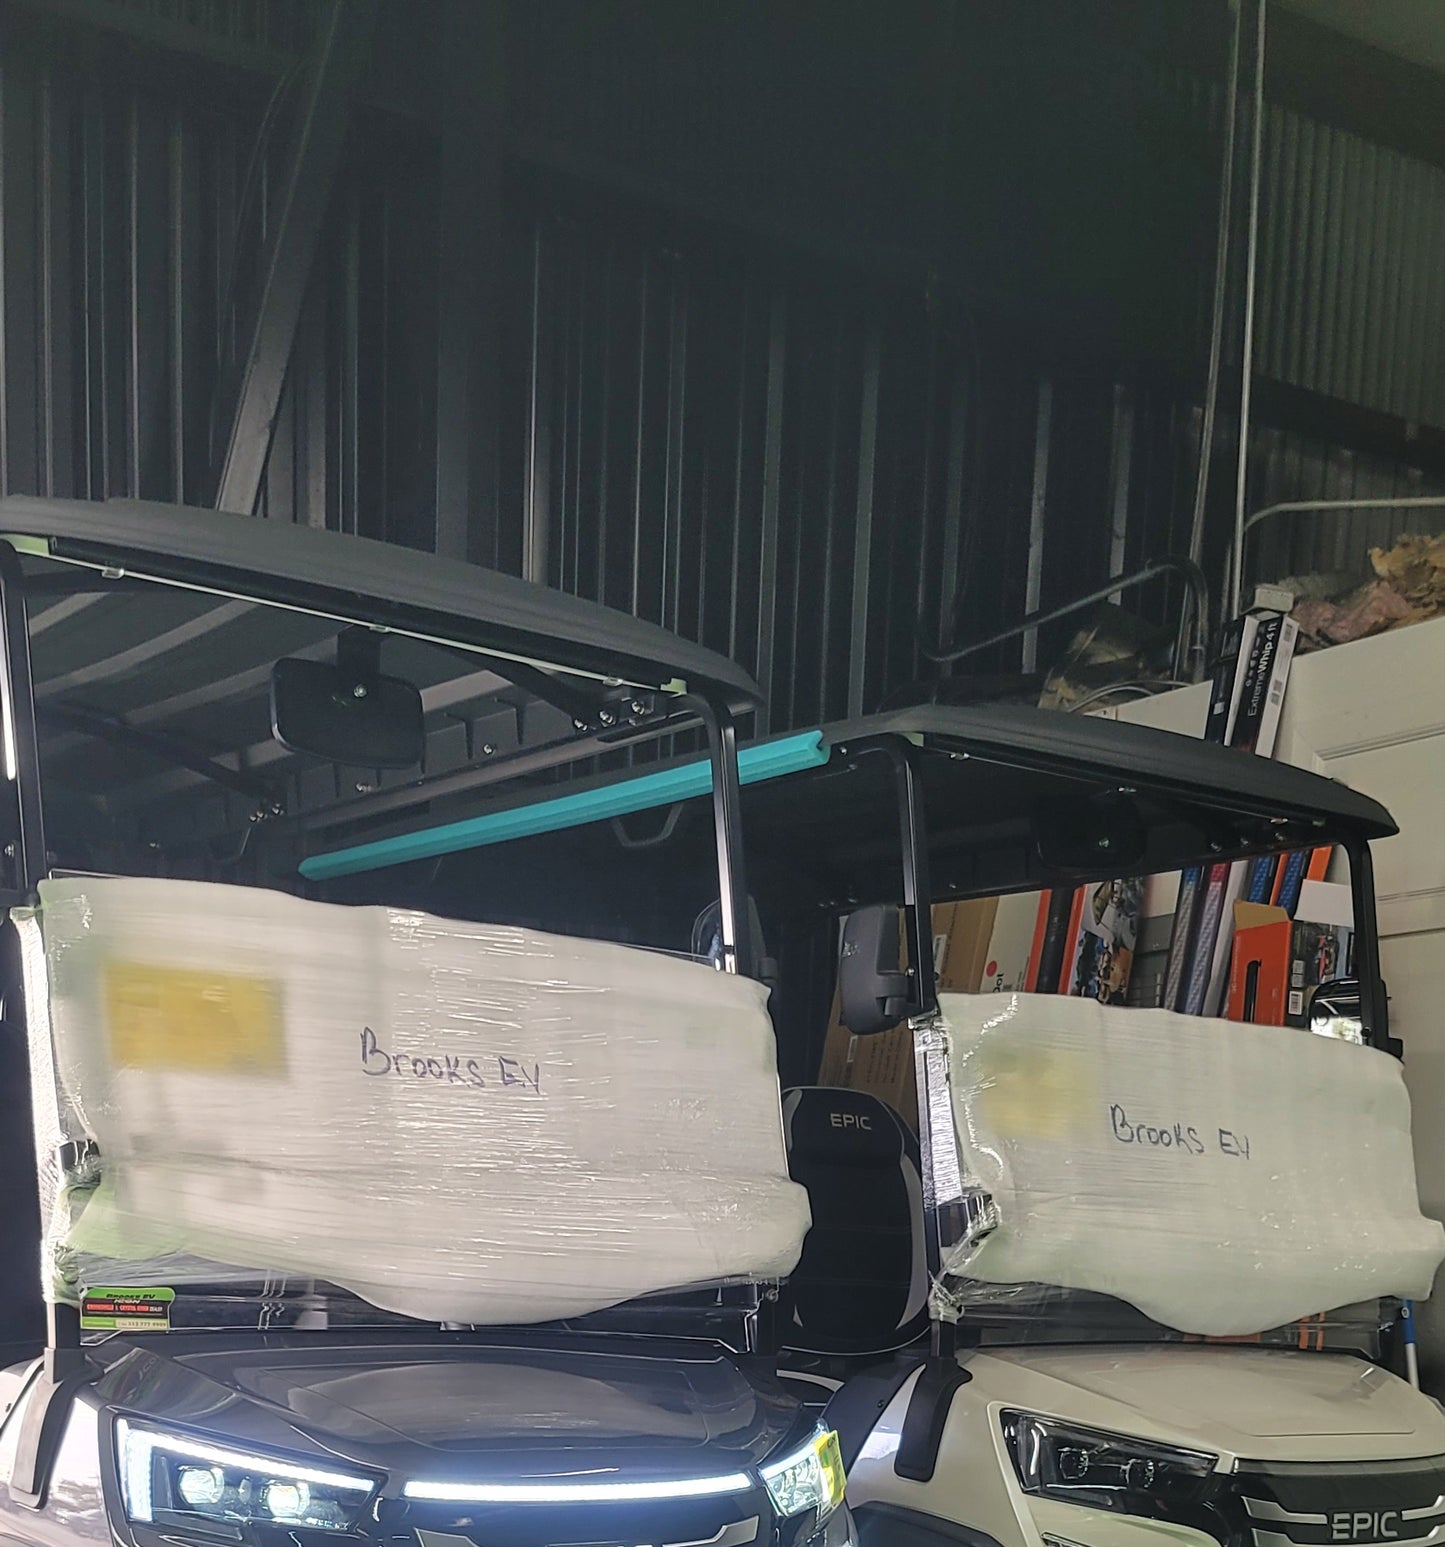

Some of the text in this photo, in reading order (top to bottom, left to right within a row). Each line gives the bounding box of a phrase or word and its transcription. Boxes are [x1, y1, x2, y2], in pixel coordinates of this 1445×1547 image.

[1248, 643, 1274, 716] ExtremeWhip
[1266, 632, 1276, 641] 4
[830, 1112, 872, 1130] EPIC
[1331, 1511, 1399, 1540] EPIC
